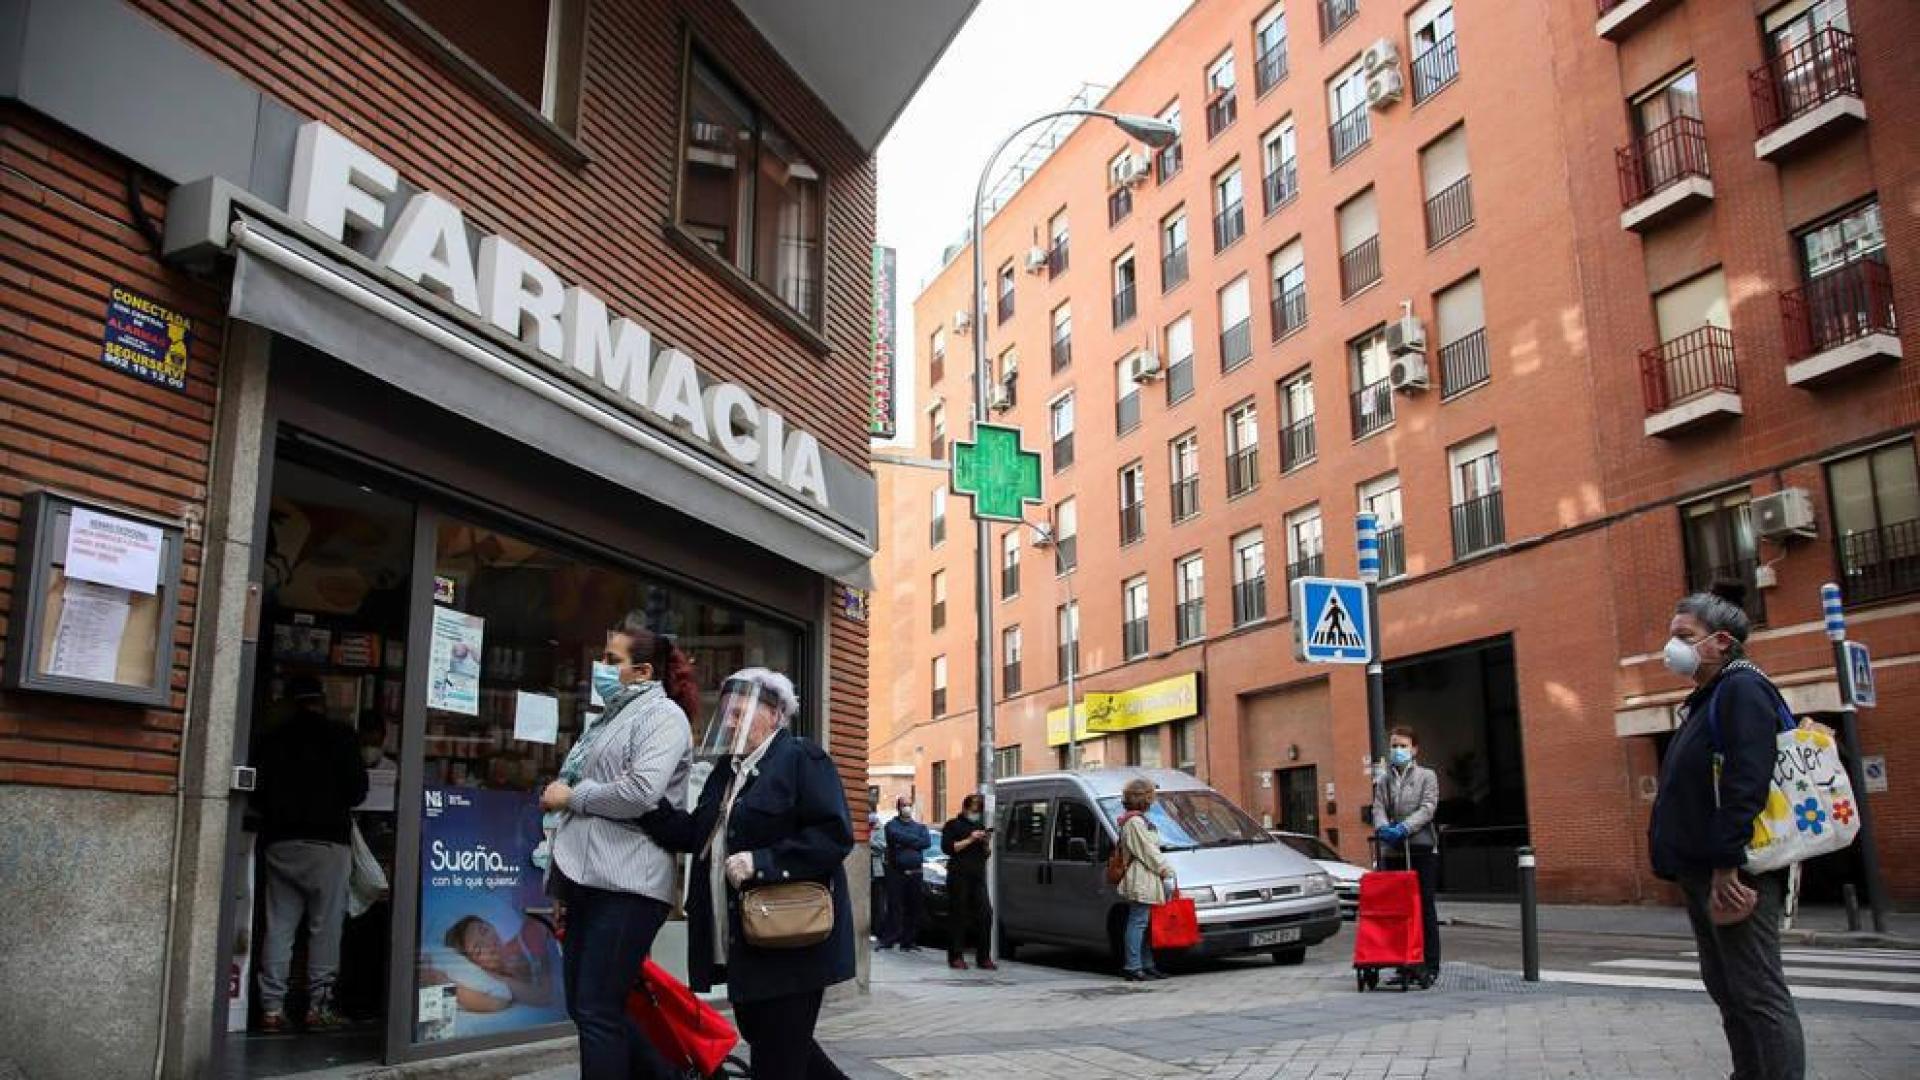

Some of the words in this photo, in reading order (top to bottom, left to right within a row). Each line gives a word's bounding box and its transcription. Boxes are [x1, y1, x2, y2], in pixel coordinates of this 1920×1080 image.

[289, 121, 830, 507] FARMACIA
[432, 876, 450, 887] con
[453, 874, 462, 887] lo
[465, 876, 484, 890] que
